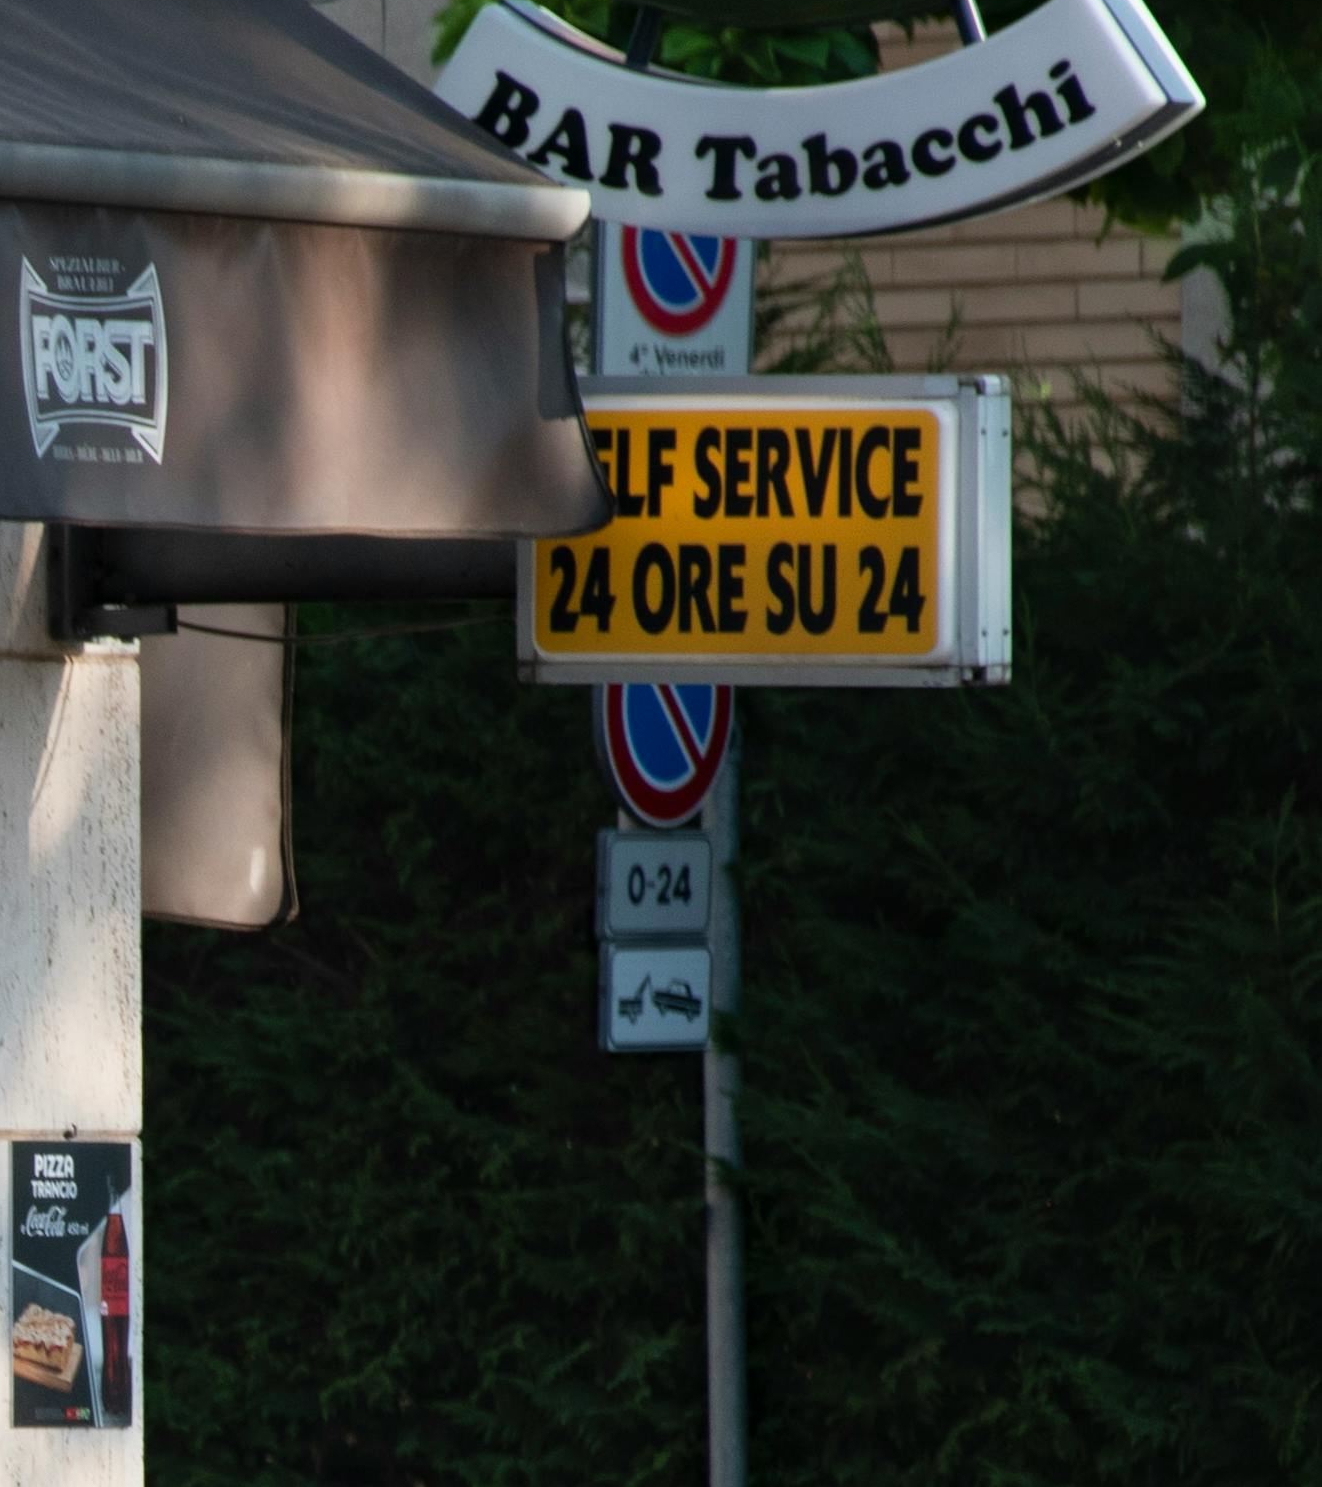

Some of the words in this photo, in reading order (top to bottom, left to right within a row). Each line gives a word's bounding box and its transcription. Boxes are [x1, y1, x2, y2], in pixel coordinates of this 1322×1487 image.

[473, 70, 663, 196] BAR
[695, 60, 1096, 202] Tabacchi
[32, 314, 154, 405] FORST
[592, 427, 676, 518] LF
[694, 424, 923, 520] SERVICE
[550, 545, 616, 633] 24
[632, 542, 748, 635] ORE
[766, 542, 837, 635] SU
[858, 545, 926, 634] 24
[628, 861, 691, 906] 0-24
[30, 1180, 78, 1199] TRANCIO
[34, 1154, 75, 1178] PIZZA
